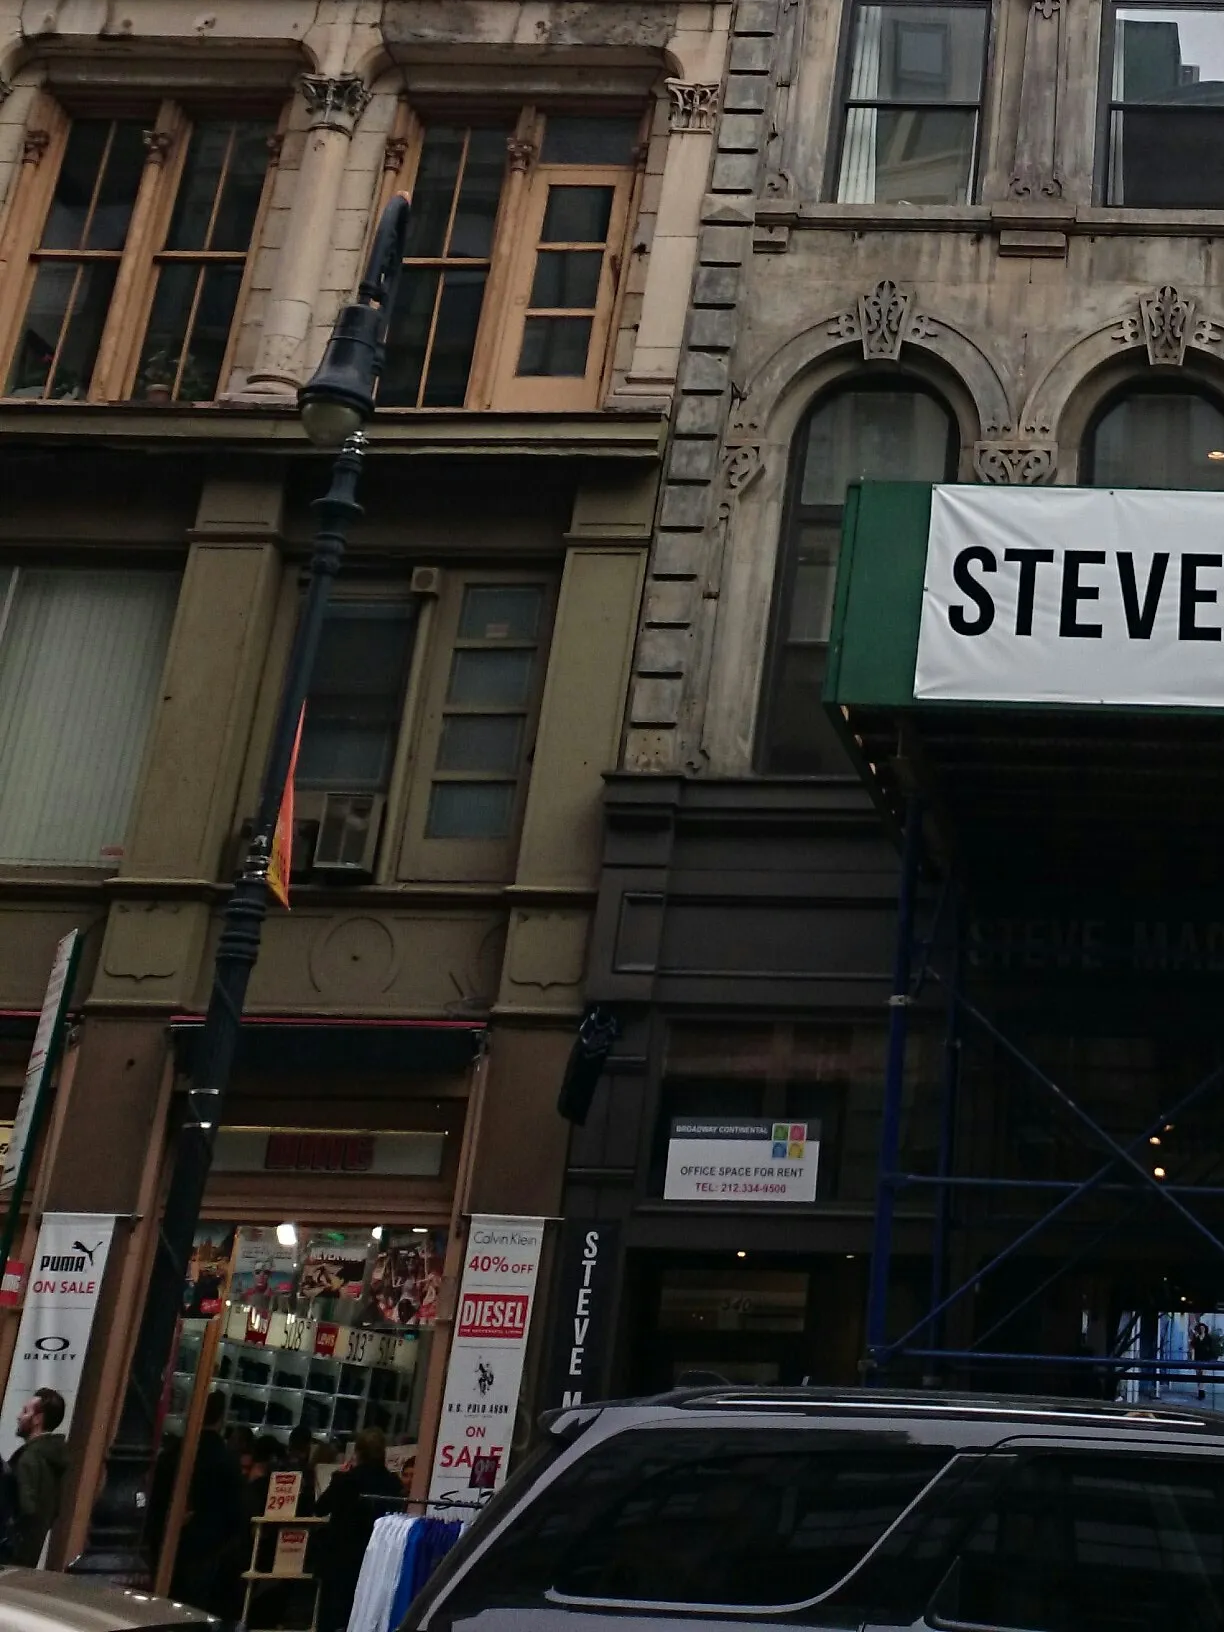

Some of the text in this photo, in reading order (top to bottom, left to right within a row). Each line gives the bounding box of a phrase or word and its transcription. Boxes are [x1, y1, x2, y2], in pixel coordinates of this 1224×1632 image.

[947, 545, 1224, 642] STEVE
[675, 1124, 769, 1135] BROADWAY CONTINENTAL
[680, 1166, 804, 1178] OFFICE SPACE FOR RENT
[695, 1182, 718, 1192] TEL:
[473, 1230, 537, 1246] Calvin Klein
[40, 1255, 86, 1272] PUMA
[468, 1255, 534, 1274] 40% OFF
[33, 1280, 96, 1294] ON SALE
[568, 1230, 600, 1376] STEVE
[460, 1300, 524, 1328] DIESEL
[23, 1353, 78, 1361] OAKLEY
[466, 1403, 487, 1414] POLO
[465, 1425, 486, 1438] ON
